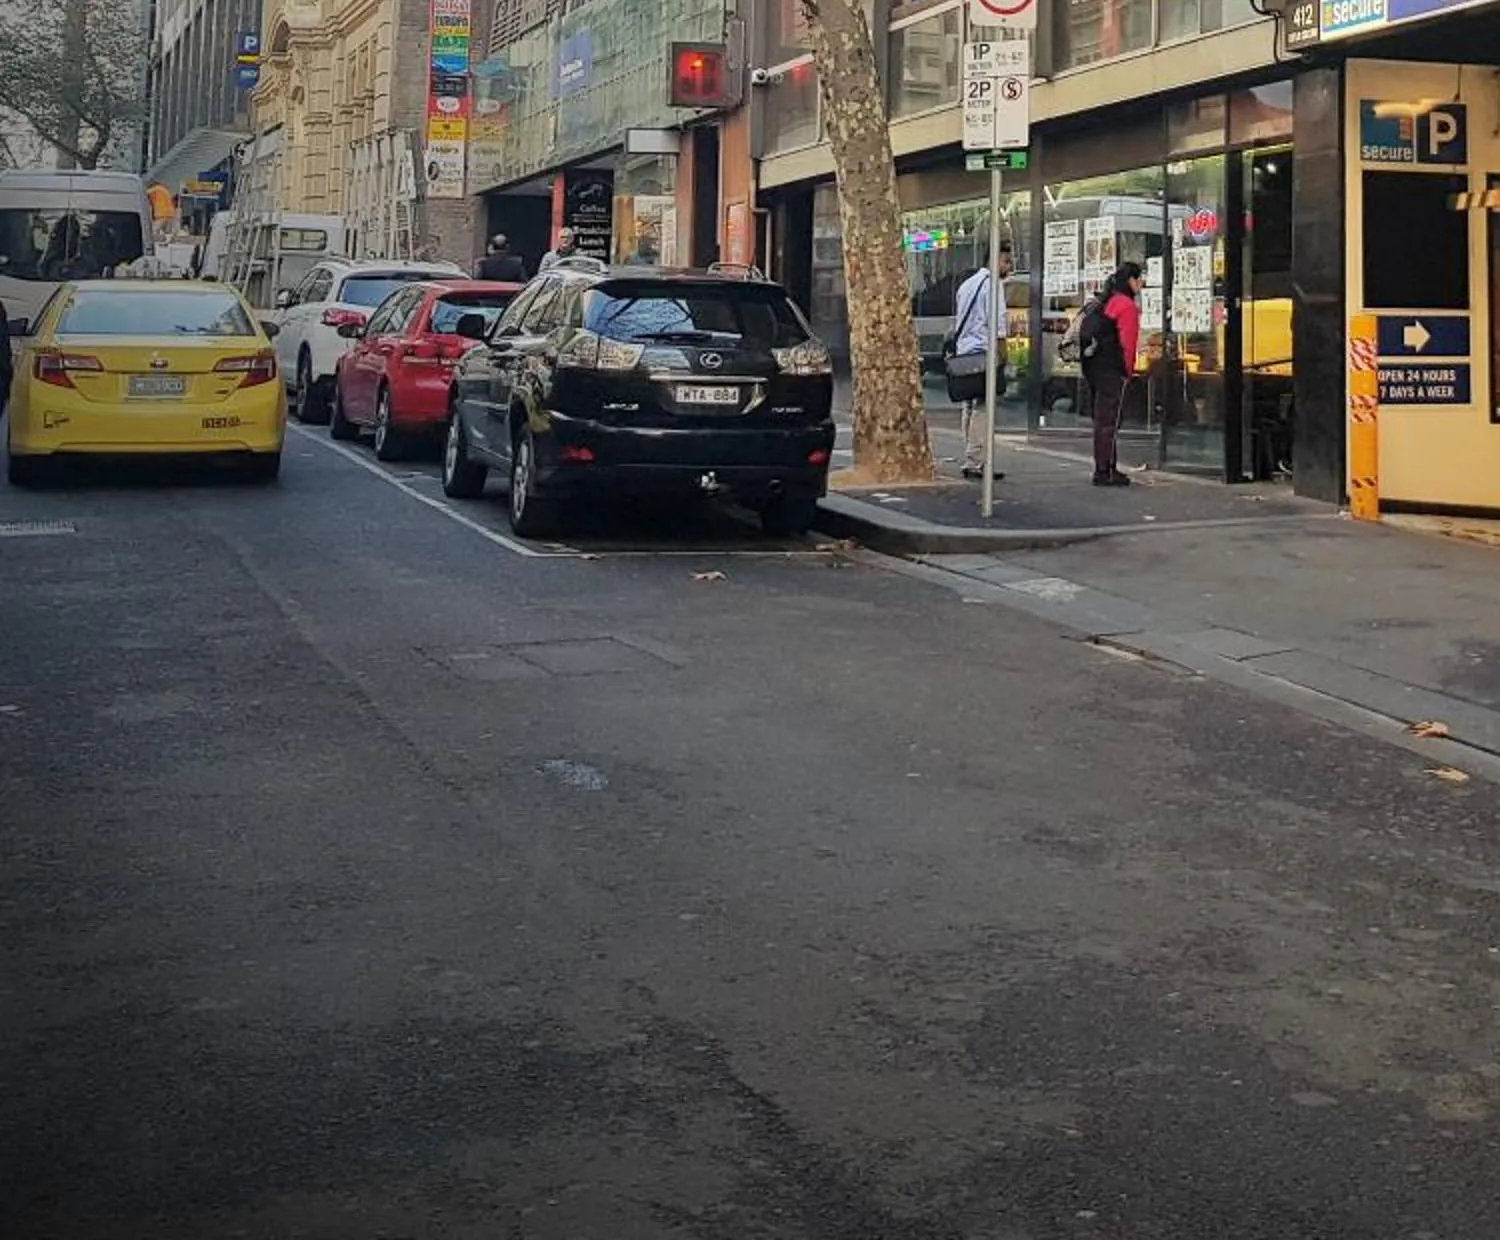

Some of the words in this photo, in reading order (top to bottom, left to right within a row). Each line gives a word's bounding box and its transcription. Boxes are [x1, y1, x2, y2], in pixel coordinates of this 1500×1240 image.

[1293, 3, 1313, 28] 412
[243, 35, 258, 51] P
[973, 43, 991, 60] 1P
[968, 81, 991, 99] 2P
[1429, 113, 1458, 156] P
[1361, 143, 1413, 161] secure
[1377, 369, 1404, 382] OPEN
[1406, 369, 1420, 382] 24
[1422, 369, 1457, 382] HOURS
[1379, 385, 1386, 398] 7
[1388, 385, 1415, 398] DAYS
[1417, 385, 1425, 398] A
[1427, 385, 1455, 399] WEEK
